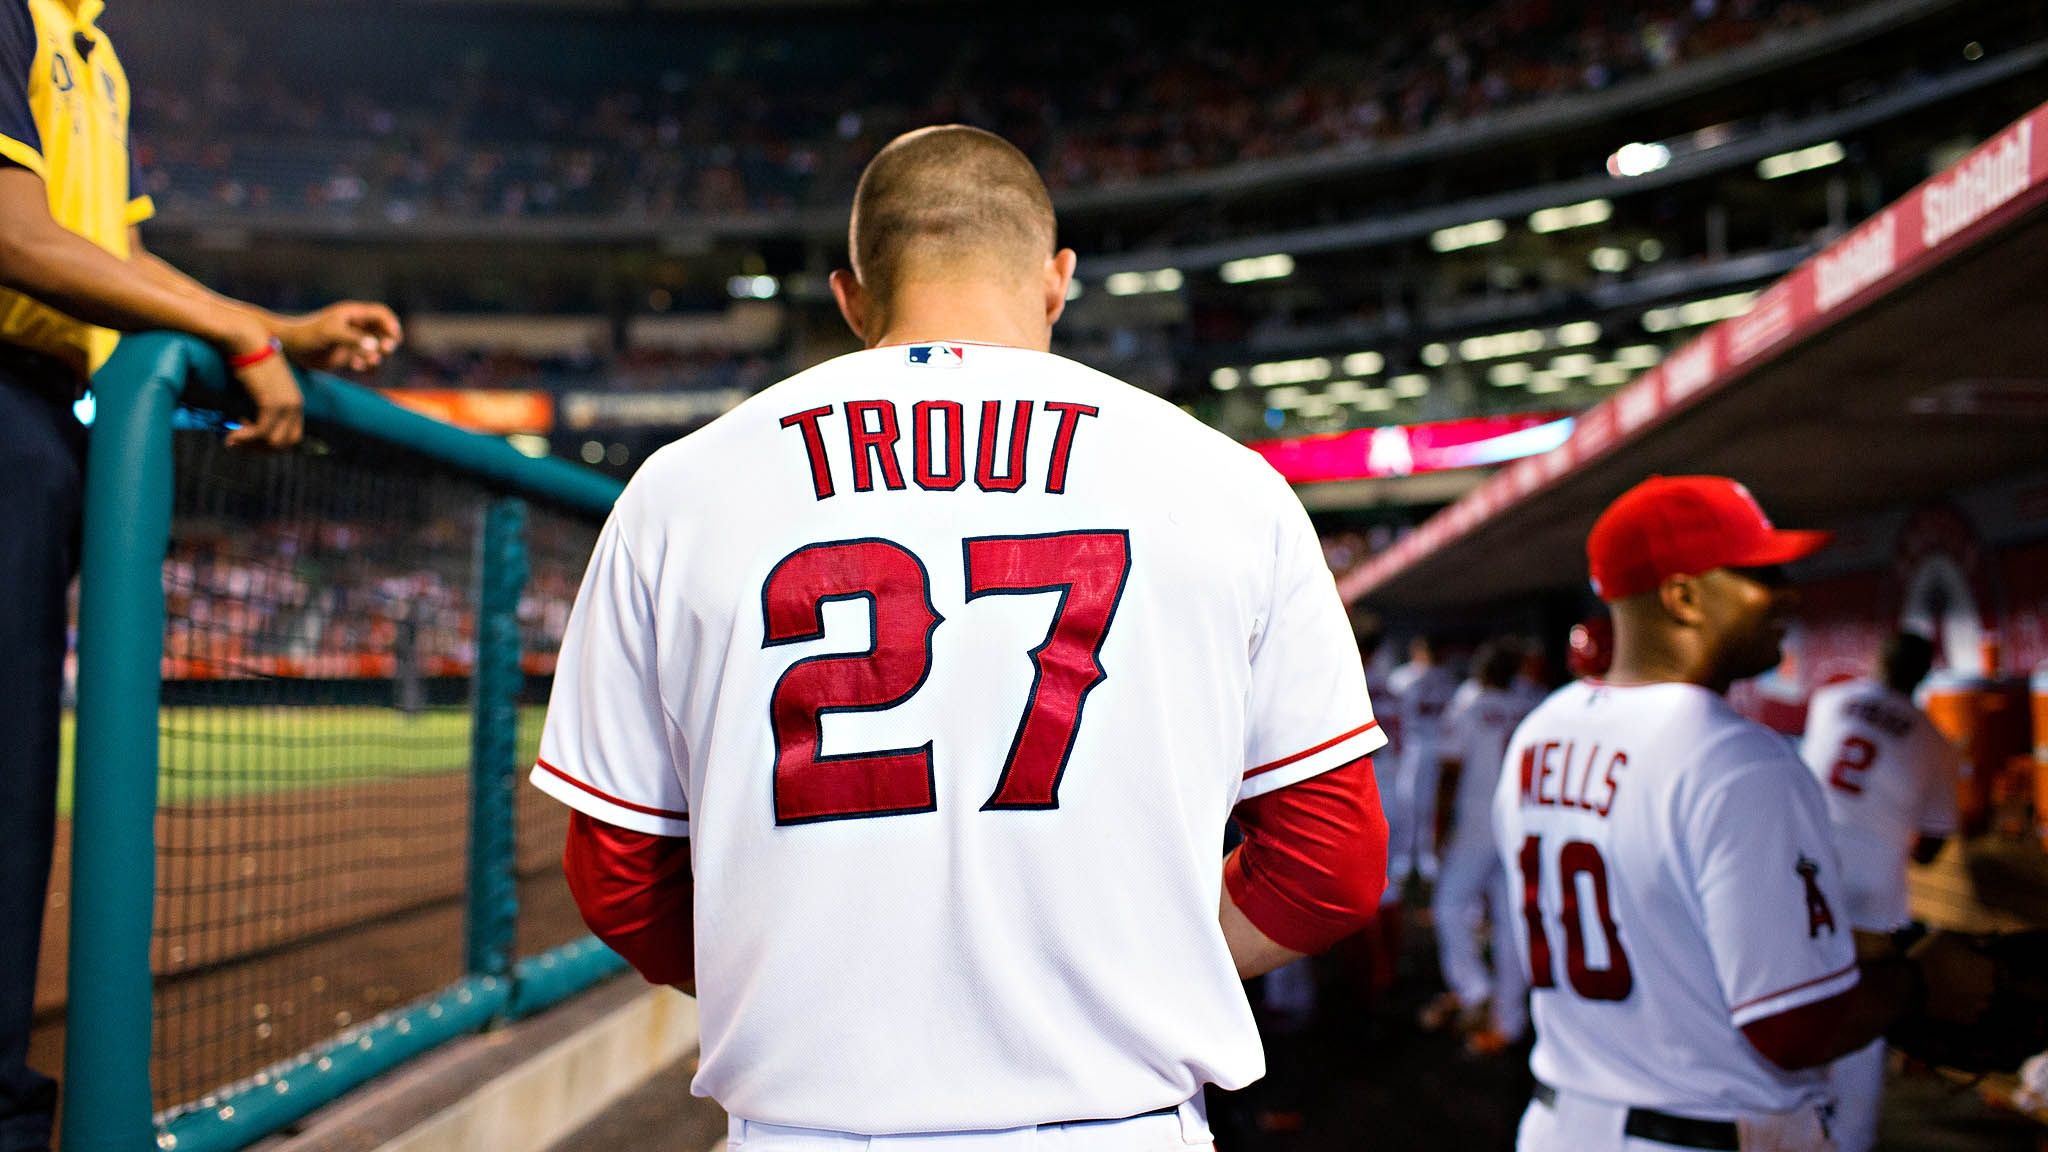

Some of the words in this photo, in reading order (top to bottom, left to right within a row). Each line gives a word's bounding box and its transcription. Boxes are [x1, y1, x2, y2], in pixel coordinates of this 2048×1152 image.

[780, 399, 1099, 501] TROUT
[761, 528, 1132, 826] 27
[1519, 740, 1628, 817] WELLS
[1828, 735, 1877, 796] 2
[1518, 833, 1633, 1002] 10
